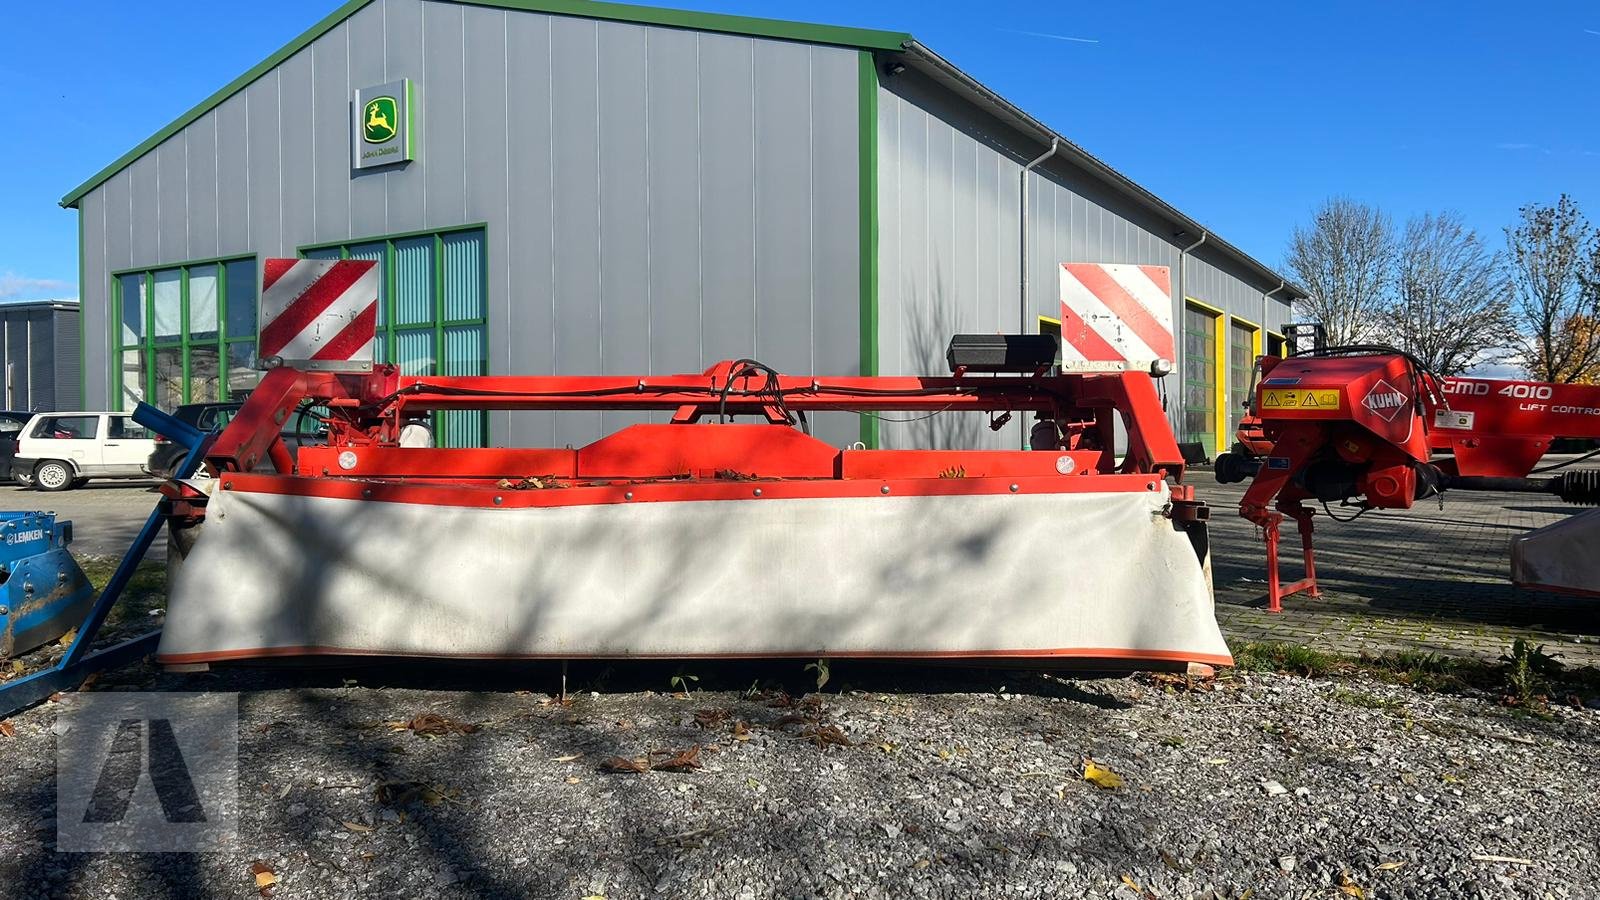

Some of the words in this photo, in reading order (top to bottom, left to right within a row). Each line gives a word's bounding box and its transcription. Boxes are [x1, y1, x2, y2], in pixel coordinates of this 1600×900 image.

[1441, 381, 1489, 395] GMD
[1498, 384, 1552, 399] 4010
[1368, 392, 1402, 409] KUHN
[1519, 403, 1548, 412] LIFT
[14, 529, 43, 544] LEMKEN
